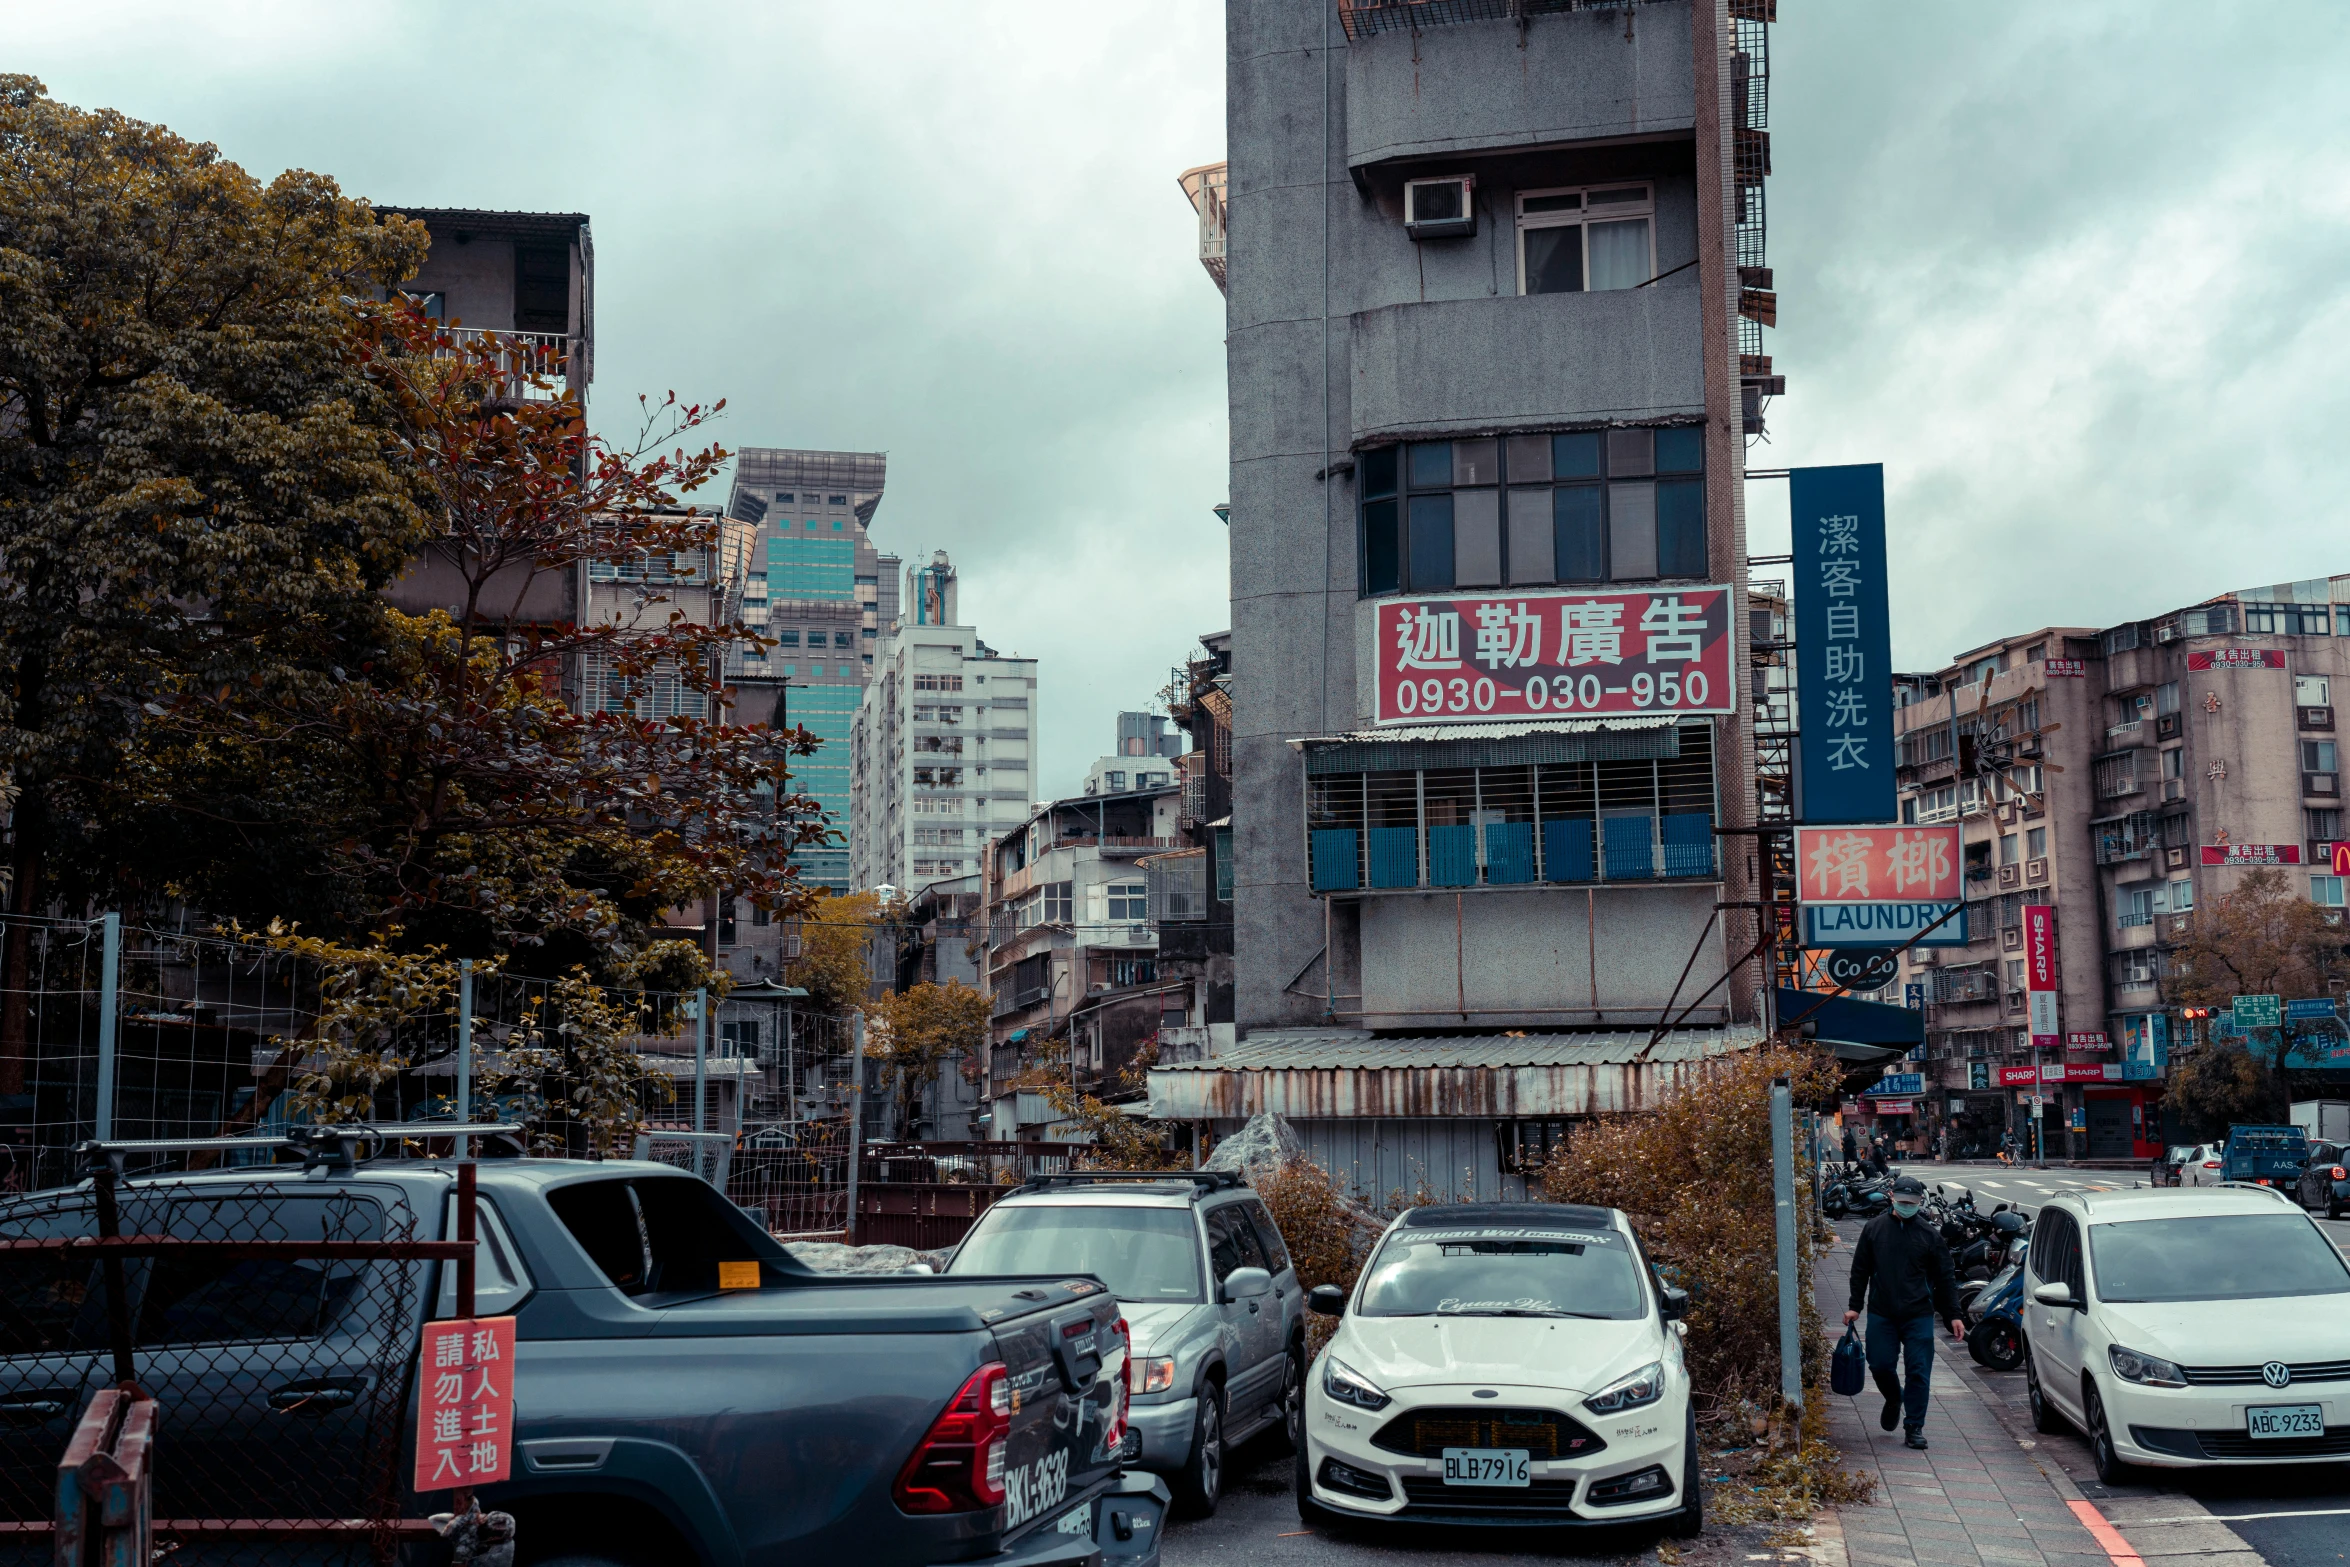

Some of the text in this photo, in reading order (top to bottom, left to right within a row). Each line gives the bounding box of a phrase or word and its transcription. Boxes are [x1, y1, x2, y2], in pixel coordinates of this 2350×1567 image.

[1396, 596, 1708, 673] 迦勒廣告
[1818, 514, 1870, 771] 潔客自助洗衣
[2210, 660, 2266, 669] 0930-030-950
[2215, 648, 2261, 660] 廣告出租
[1396, 670, 1709, 714] 0930-030-950
[1809, 830, 1951, 898] 檳榔
[2224, 856, 2280, 864] 0930-030-950
[2228, 845, 2275, 856] 廣告出租
[1819, 904, 1952, 930] LAUNDRY
[2033, 914, 2047, 982] SHARP
[2070, 1034, 2104, 1043] 廣告出租
[1972, 1063, 1989, 1089] 扁食
[2006, 1070, 2036, 1081] SHARP
[432, 1332, 465, 1482] 請勿進入
[469, 1329, 500, 1473] 私人土地
[1005, 1446, 1069, 1529] BKL-3638
